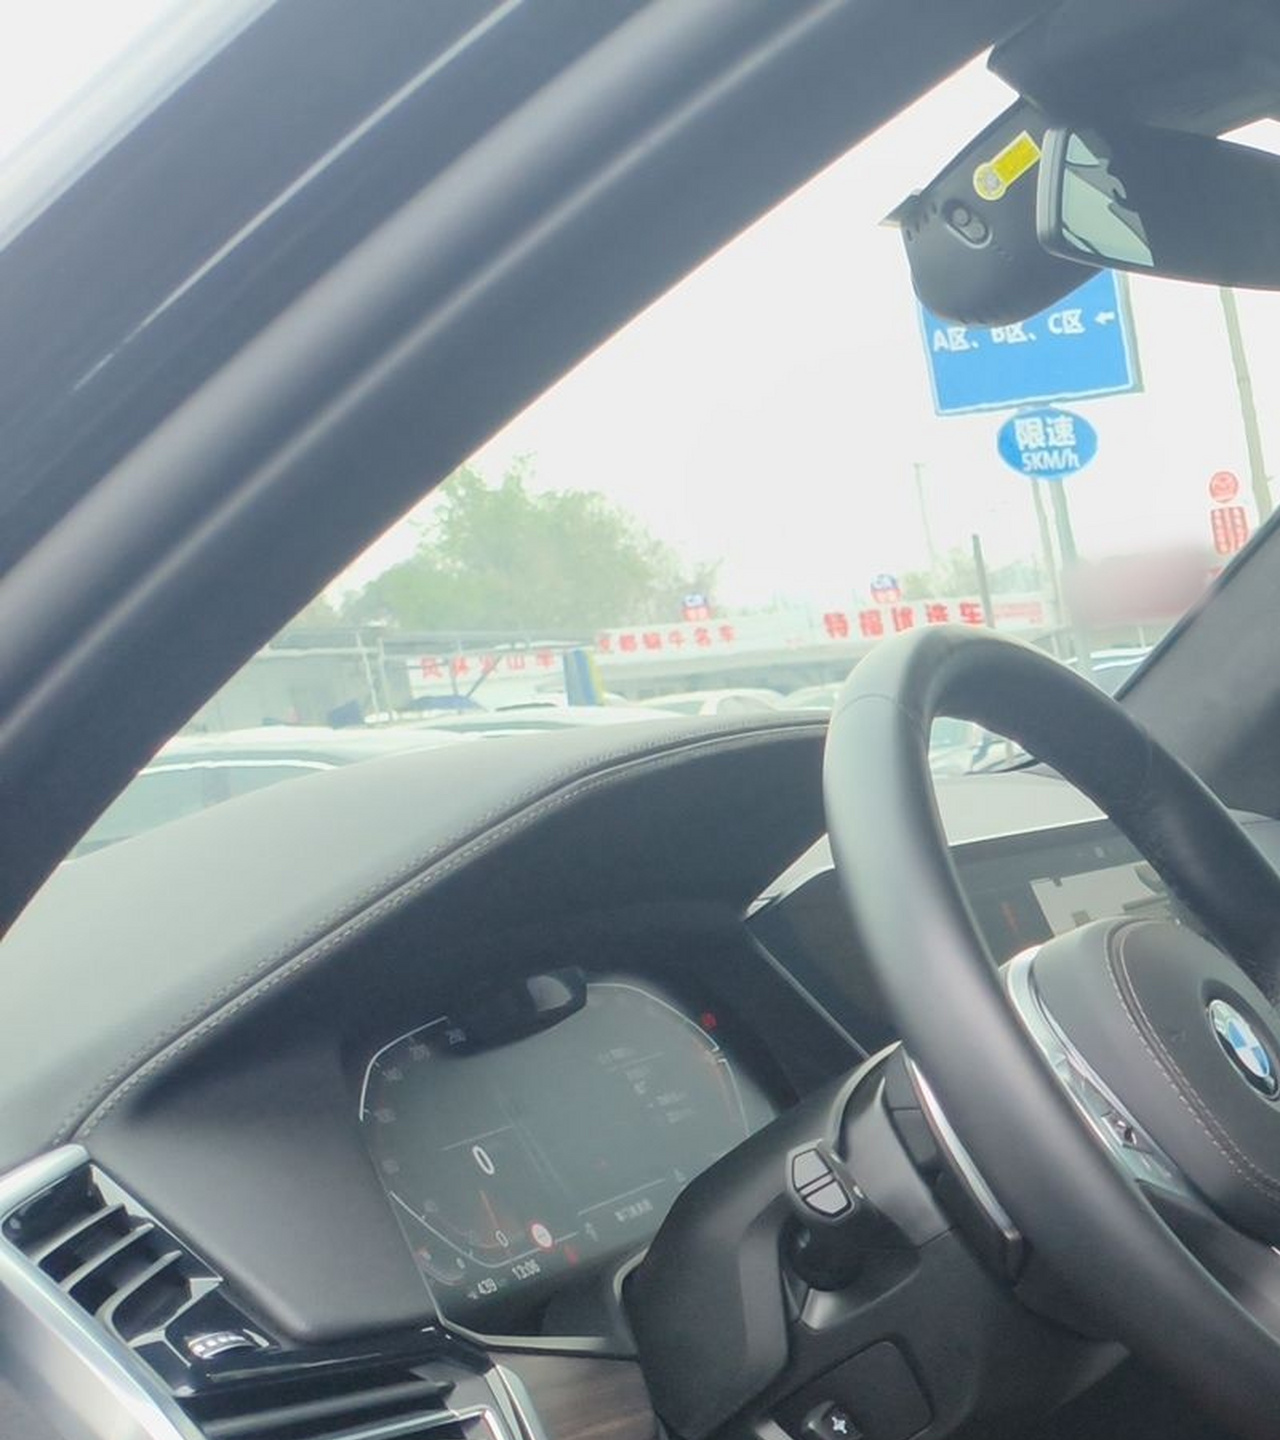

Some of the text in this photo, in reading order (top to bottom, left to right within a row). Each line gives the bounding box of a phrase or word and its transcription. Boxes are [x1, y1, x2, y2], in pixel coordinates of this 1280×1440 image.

[1014, 415, 1076, 450] 限速
[1021, 448, 1081, 472] 5KM/h
[472, 1146, 495, 1176] 0
